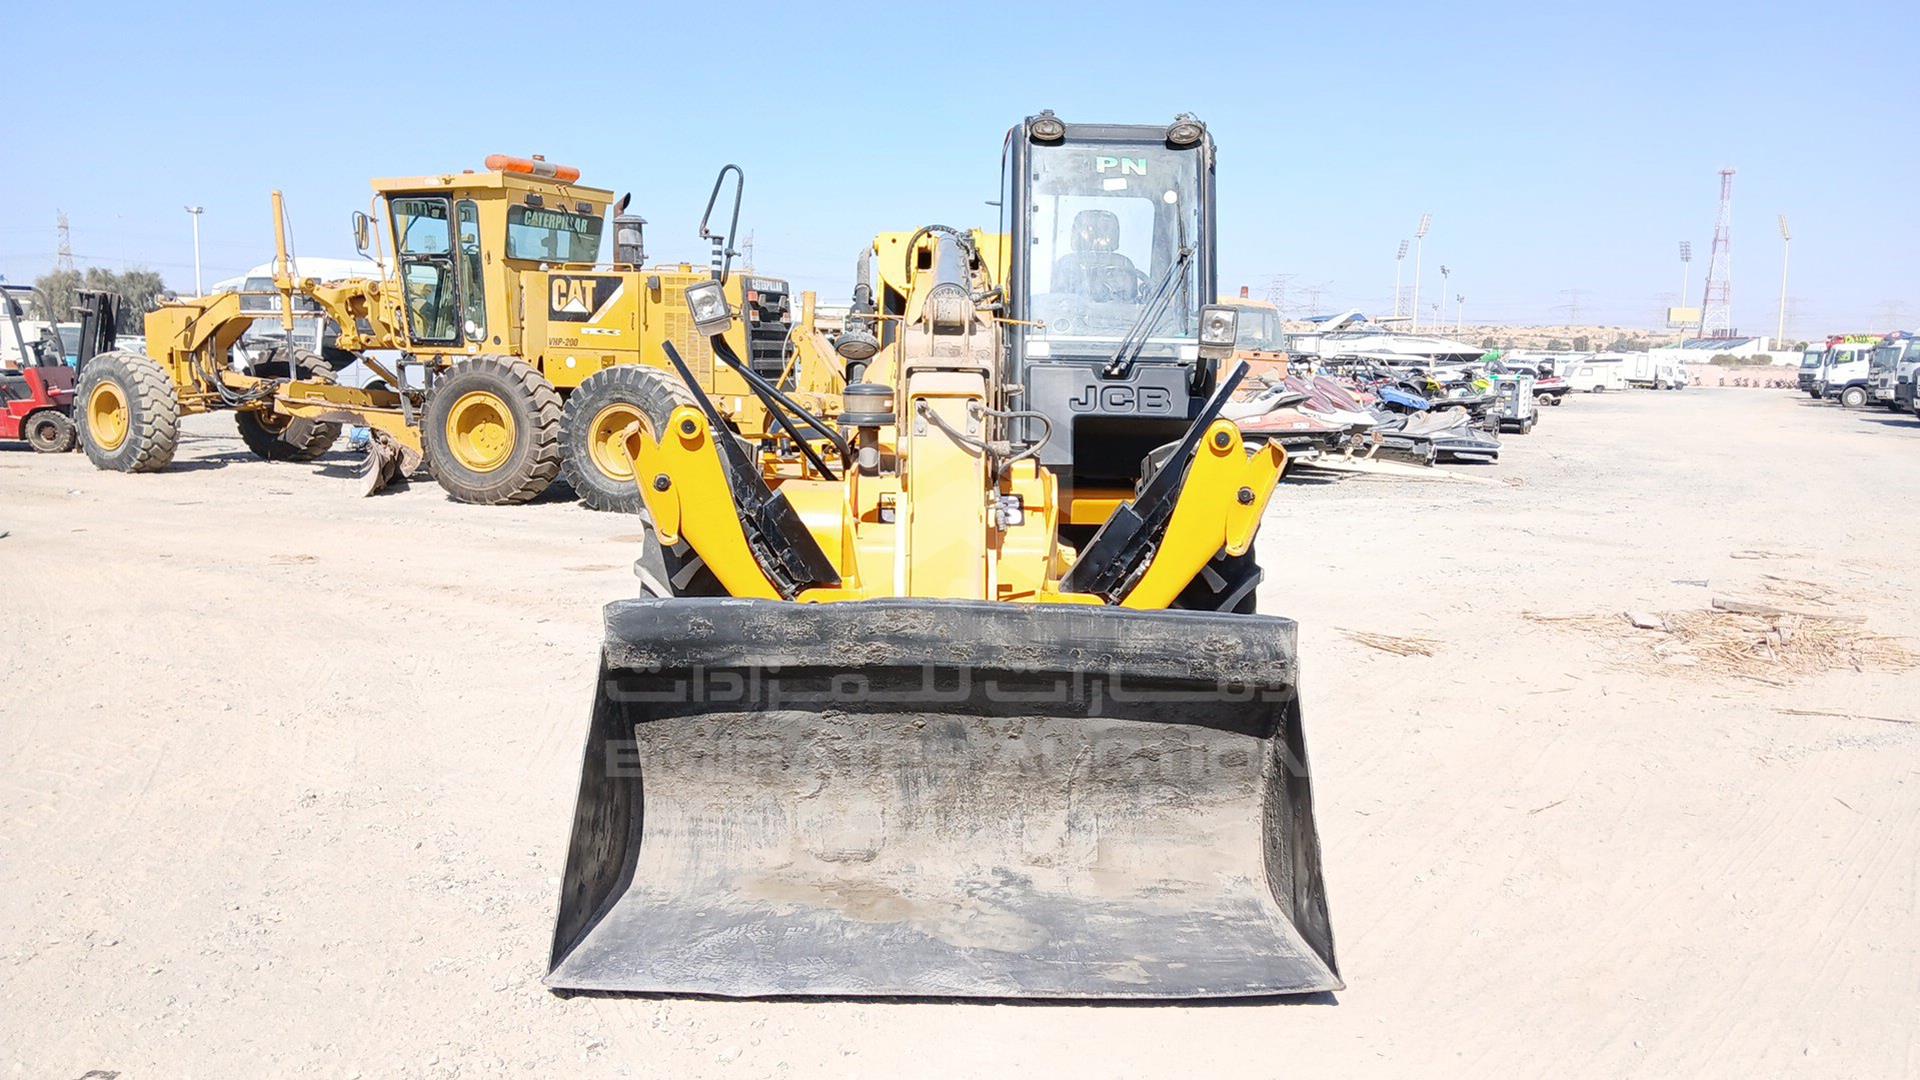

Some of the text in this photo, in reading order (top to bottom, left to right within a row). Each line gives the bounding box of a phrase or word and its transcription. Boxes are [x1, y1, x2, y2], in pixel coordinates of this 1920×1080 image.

[1096, 156, 1147, 176] PN
[524, 210, 588, 233] CATERPILLAR
[552, 278, 597, 313] CAT
[548, 337, 579, 347] VHP-200
[1069, 385, 1172, 414] JCB
